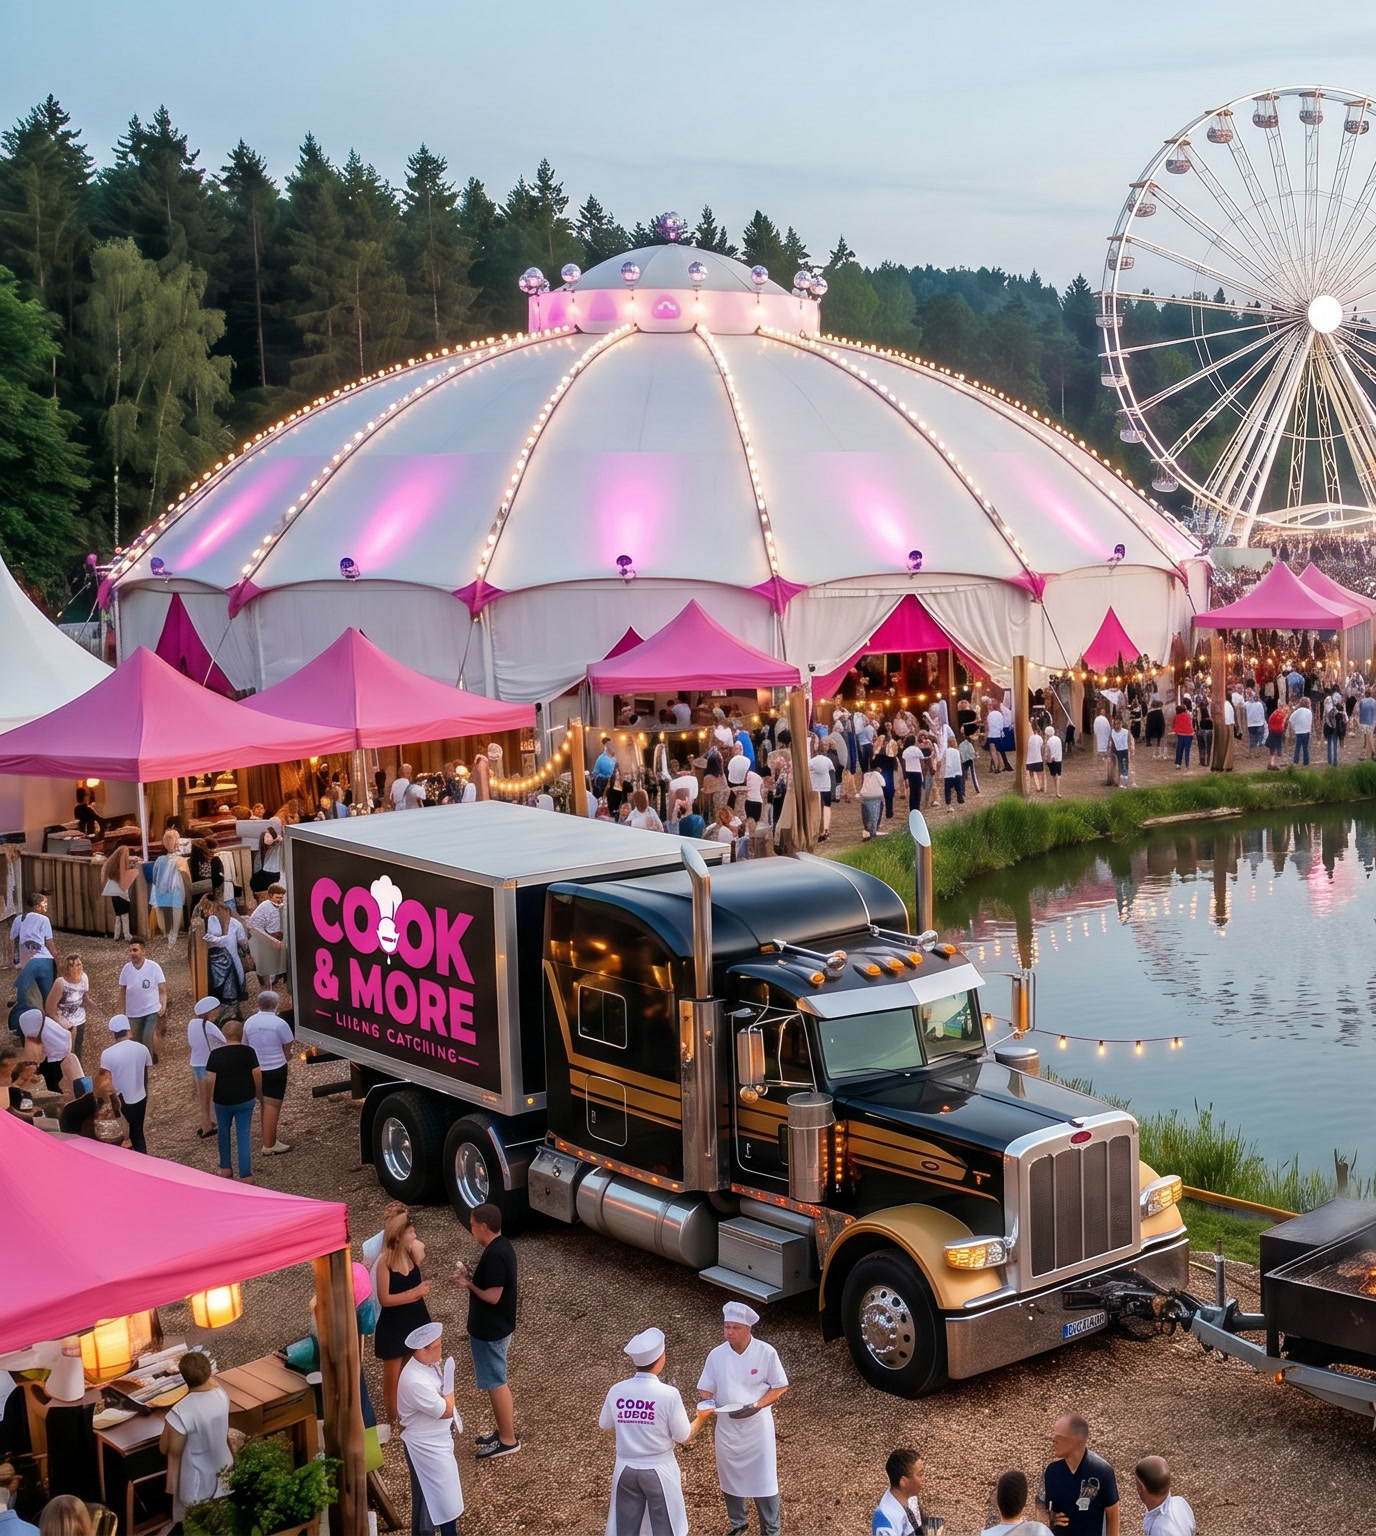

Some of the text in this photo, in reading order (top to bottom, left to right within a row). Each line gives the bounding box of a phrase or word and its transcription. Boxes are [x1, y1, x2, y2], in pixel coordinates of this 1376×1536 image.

[310, 877, 476, 985] COOK
[313, 947, 477, 1046] & MORE
